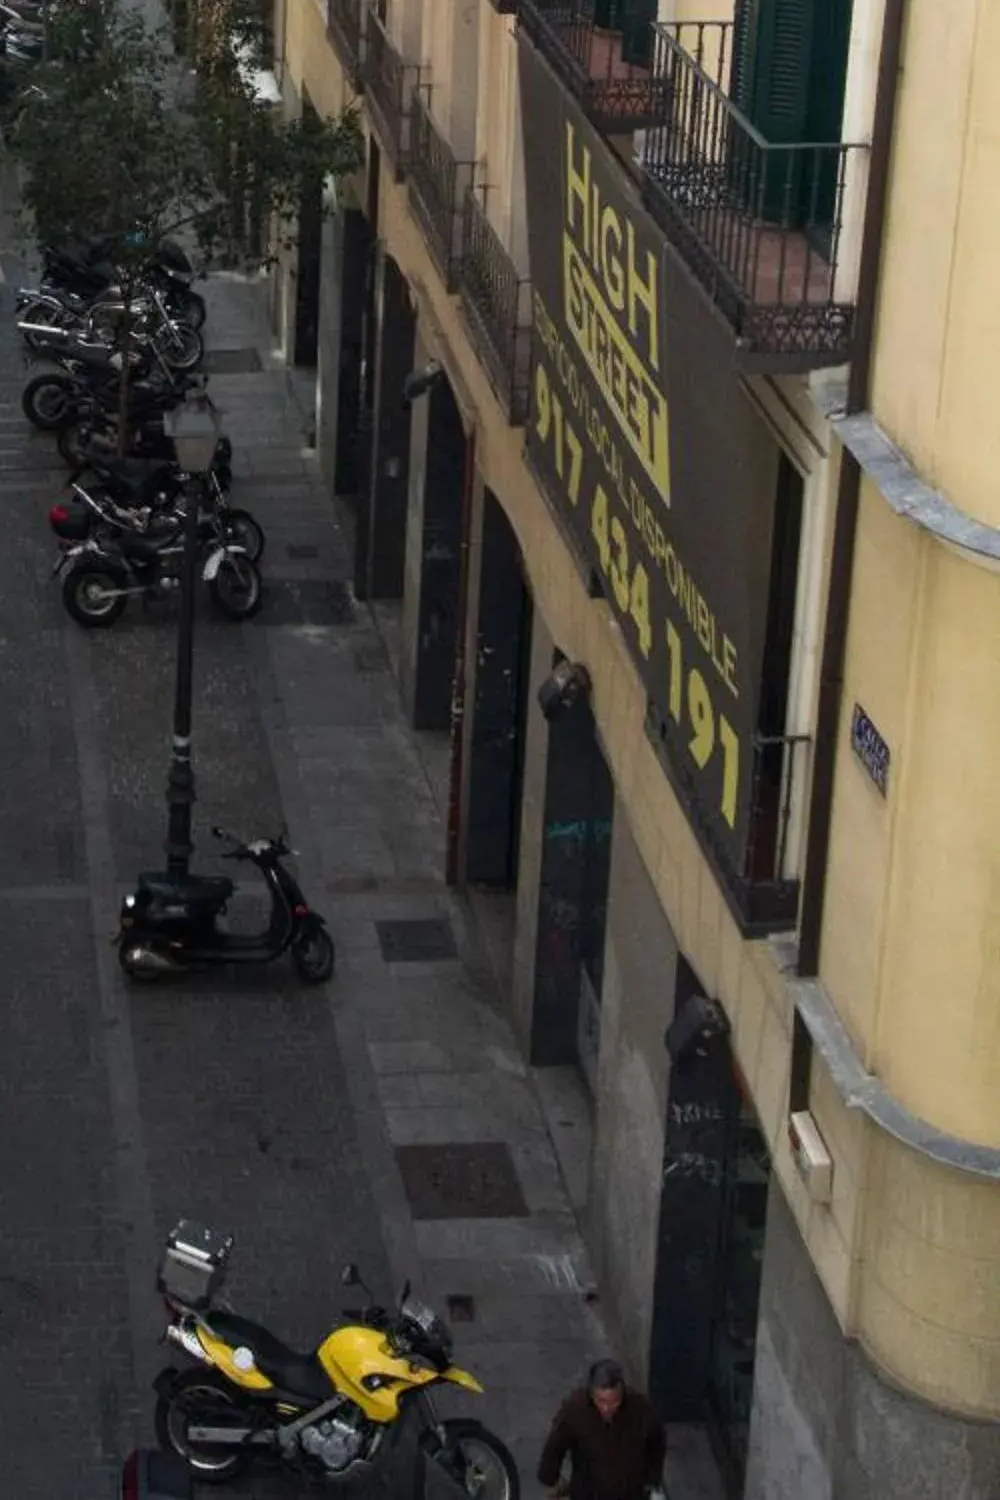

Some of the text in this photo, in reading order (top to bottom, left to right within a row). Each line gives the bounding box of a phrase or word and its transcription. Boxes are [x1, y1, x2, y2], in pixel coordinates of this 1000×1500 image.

[566, 120, 659, 372] HIGH
[570, 252, 661, 466] STREET
[536, 364, 583, 507] 917
[592, 483, 652, 661] 434
[630, 477, 739, 699] DISPONIBLE
